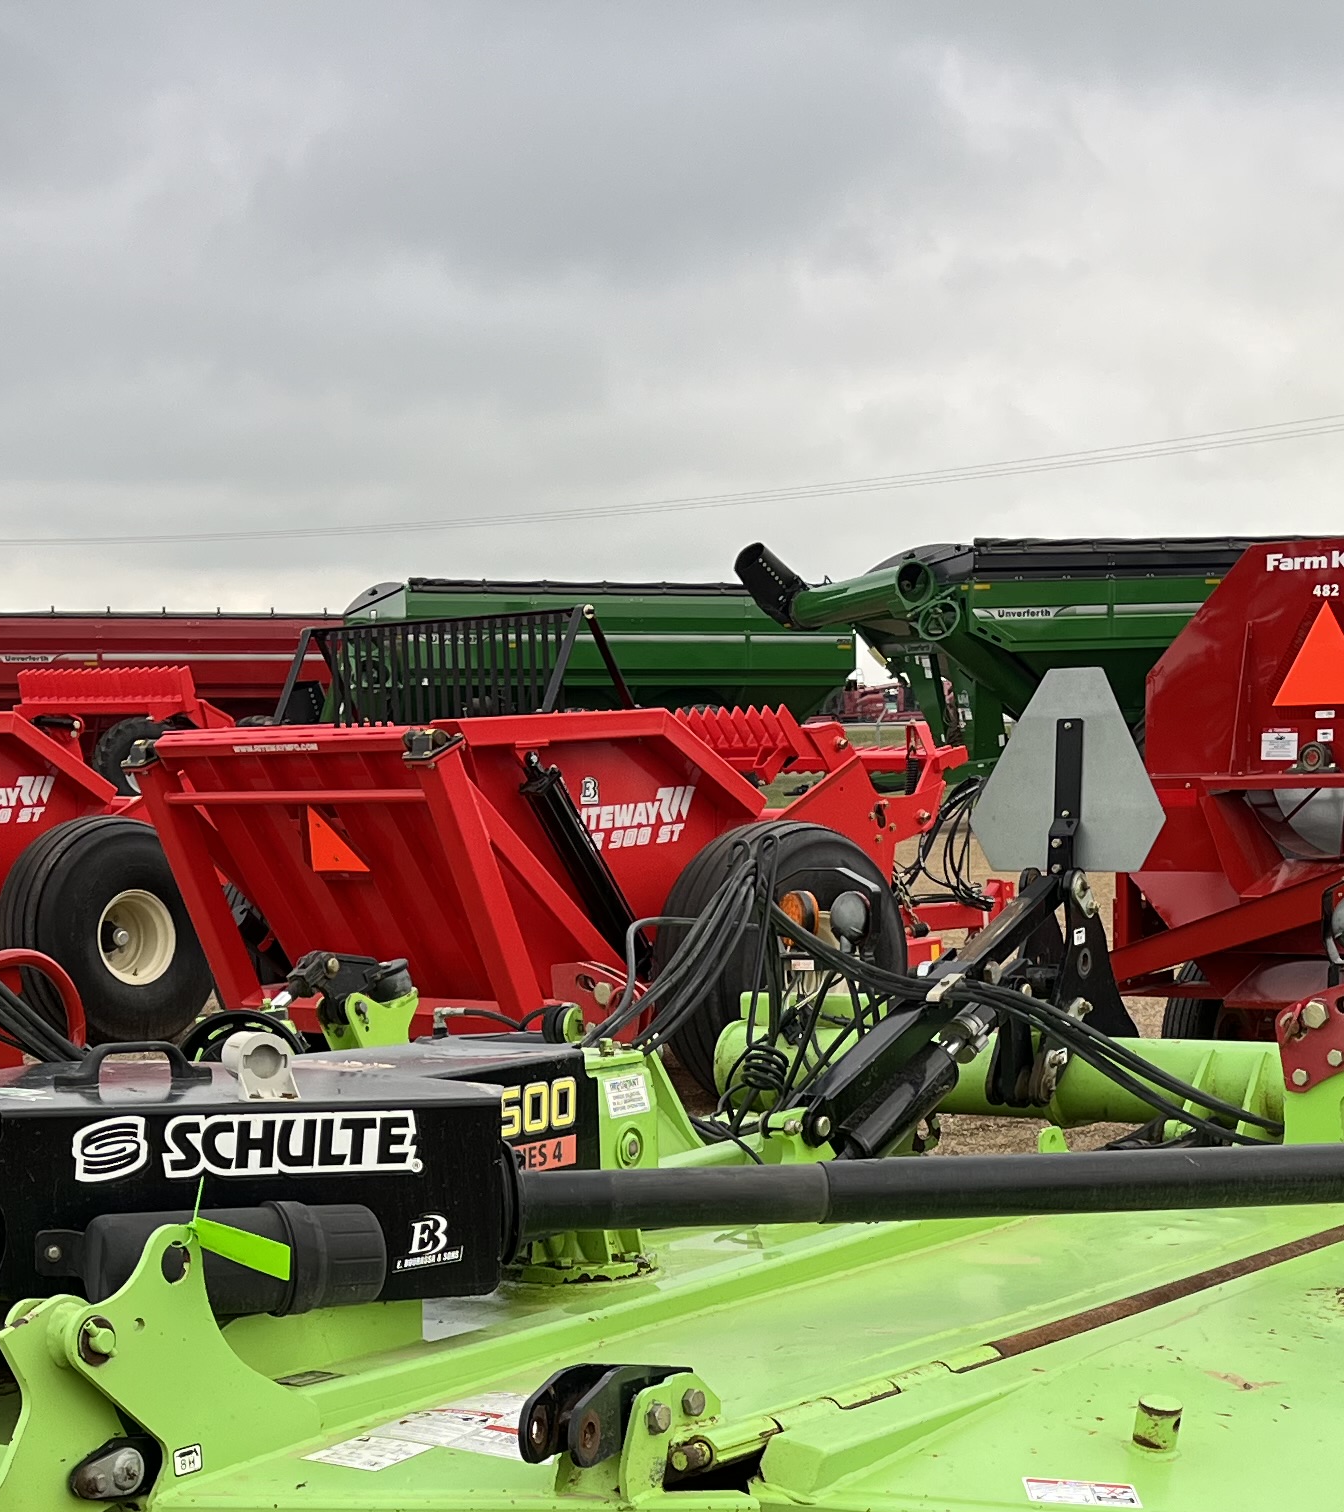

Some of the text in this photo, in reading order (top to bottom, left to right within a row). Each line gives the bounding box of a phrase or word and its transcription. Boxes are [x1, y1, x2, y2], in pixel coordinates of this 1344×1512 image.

[1266, 553, 1328, 572] Farm
[1312, 583, 1340, 597] 482
[997, 609, 1051, 618] Unverforth
[16, 806, 46, 823] ST
[580, 801, 661, 830] ITEWAY
[608, 826, 652, 849] 900
[655, 823, 685, 843] ST
[165, 1113, 418, 1176] SCHULTE
[552, 1140, 562, 1163] 4
